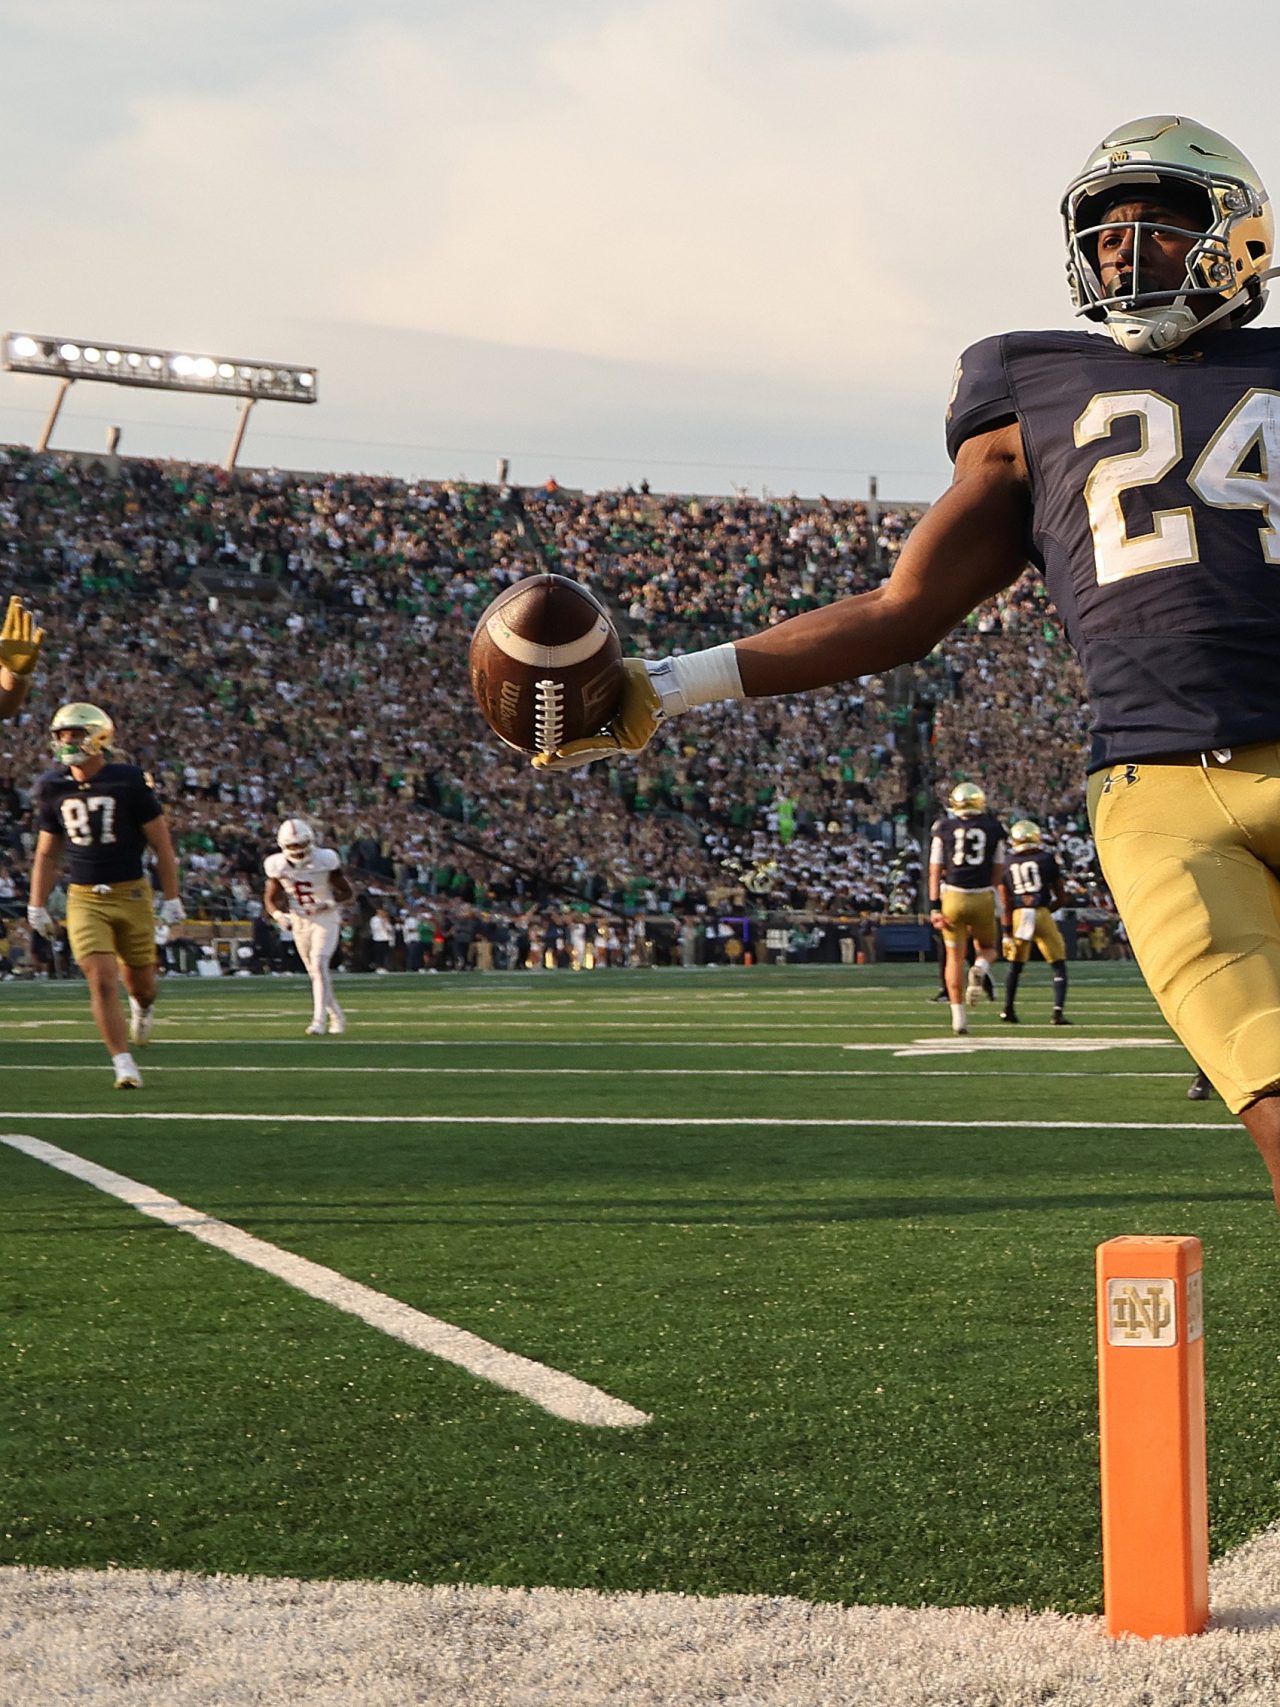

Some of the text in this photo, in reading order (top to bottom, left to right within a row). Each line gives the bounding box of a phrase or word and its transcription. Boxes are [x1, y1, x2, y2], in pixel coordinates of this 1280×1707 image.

[499, 679, 522, 734] Wilson
[60, 796, 117, 847] 87
[952, 828, 987, 867] 13
[294, 881, 316, 907] 6
[1009, 860, 1043, 895] 10
[1113, 1284, 1171, 1339] ND
